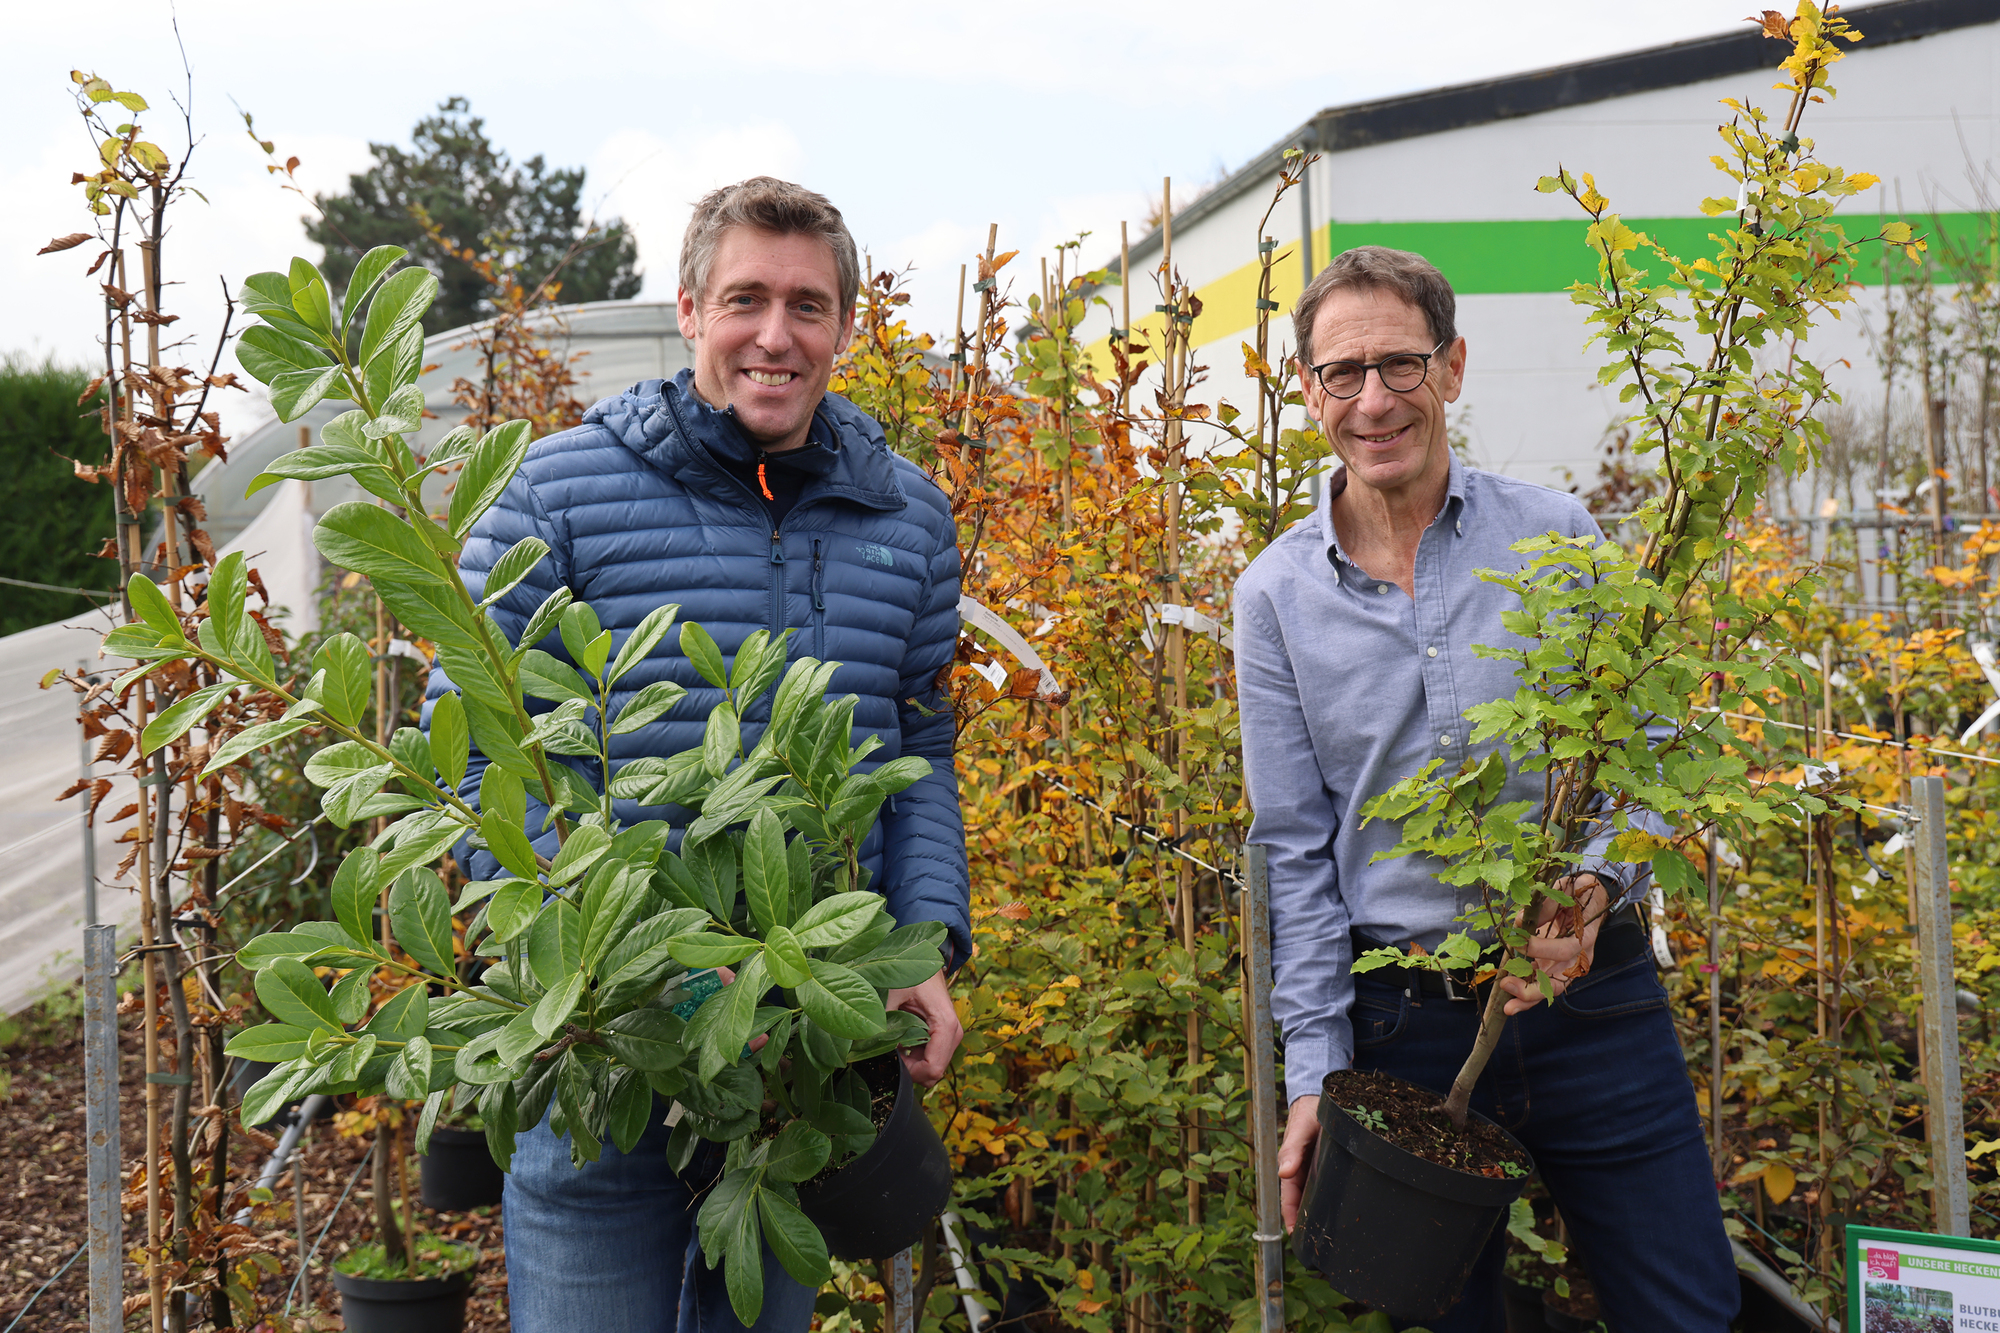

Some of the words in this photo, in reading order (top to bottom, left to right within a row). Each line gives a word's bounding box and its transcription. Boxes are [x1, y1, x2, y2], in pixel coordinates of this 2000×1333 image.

[1907, 1257, 1951, 1271] UNSERE
[1953, 1262, 2000, 1278] HECKEN
[1960, 1317, 1999, 1332] HECKE
